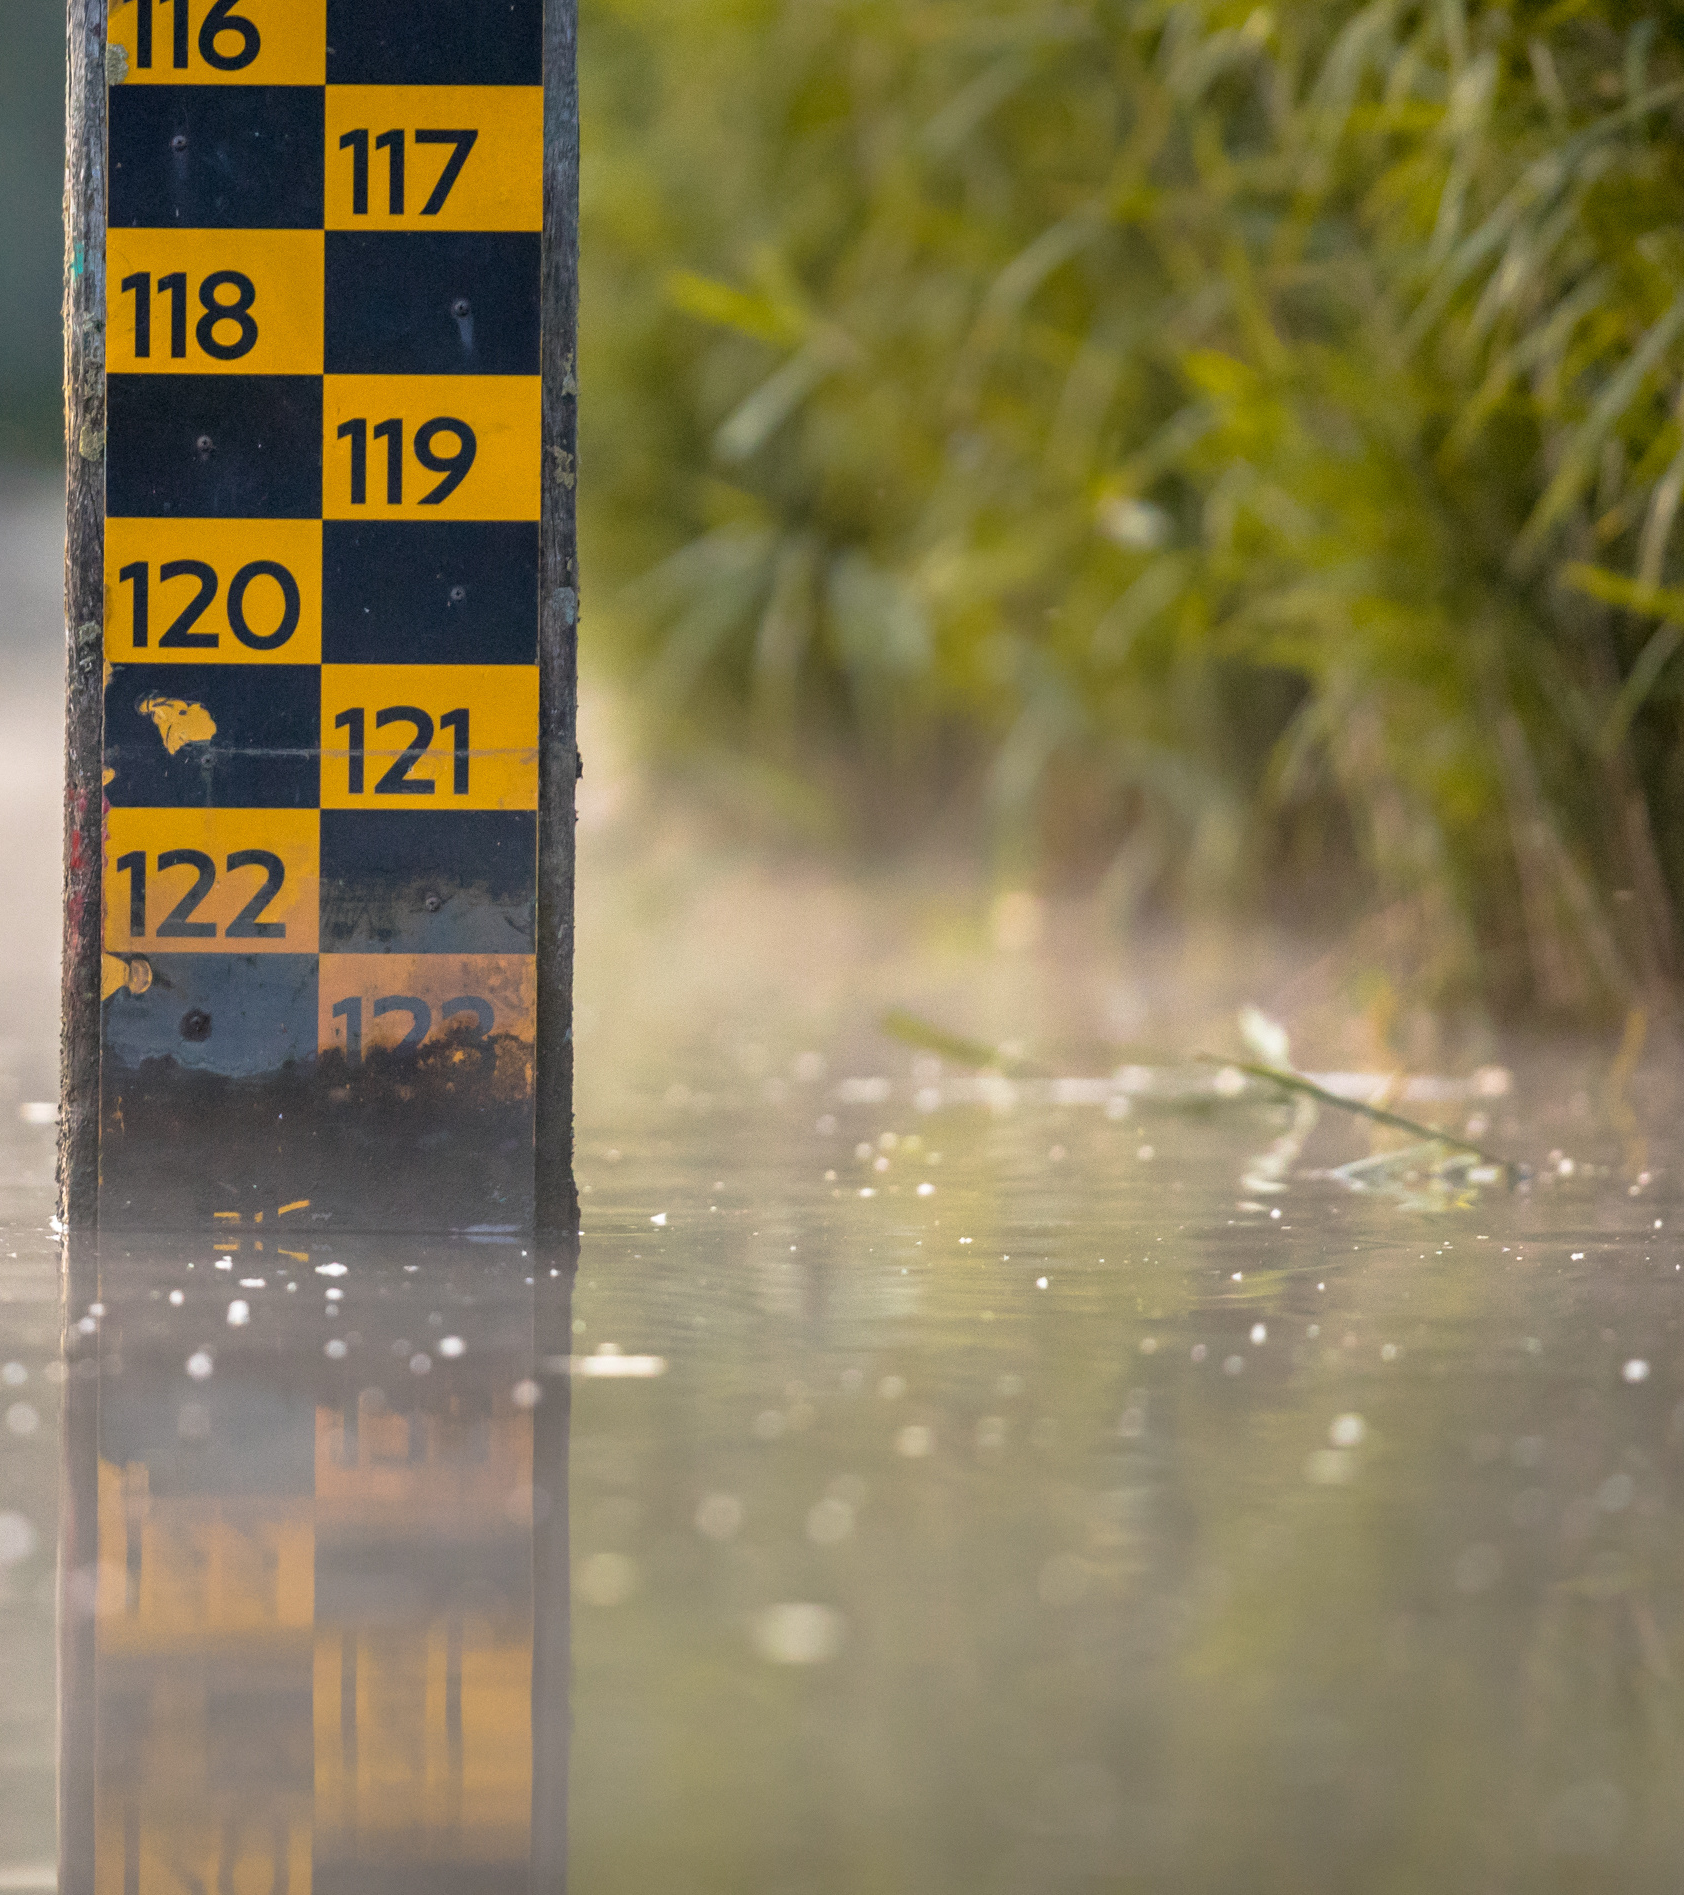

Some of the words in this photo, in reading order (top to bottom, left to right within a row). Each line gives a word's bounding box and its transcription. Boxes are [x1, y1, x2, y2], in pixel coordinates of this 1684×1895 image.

[123, 0, 261, 71] 116
[338, 128, 479, 215] 117
[121, 269, 259, 361] 118
[336, 416, 477, 505] 119
[118, 559, 301, 650] 120
[334, 705, 470, 795] 121
[115, 849, 287, 938] 122
